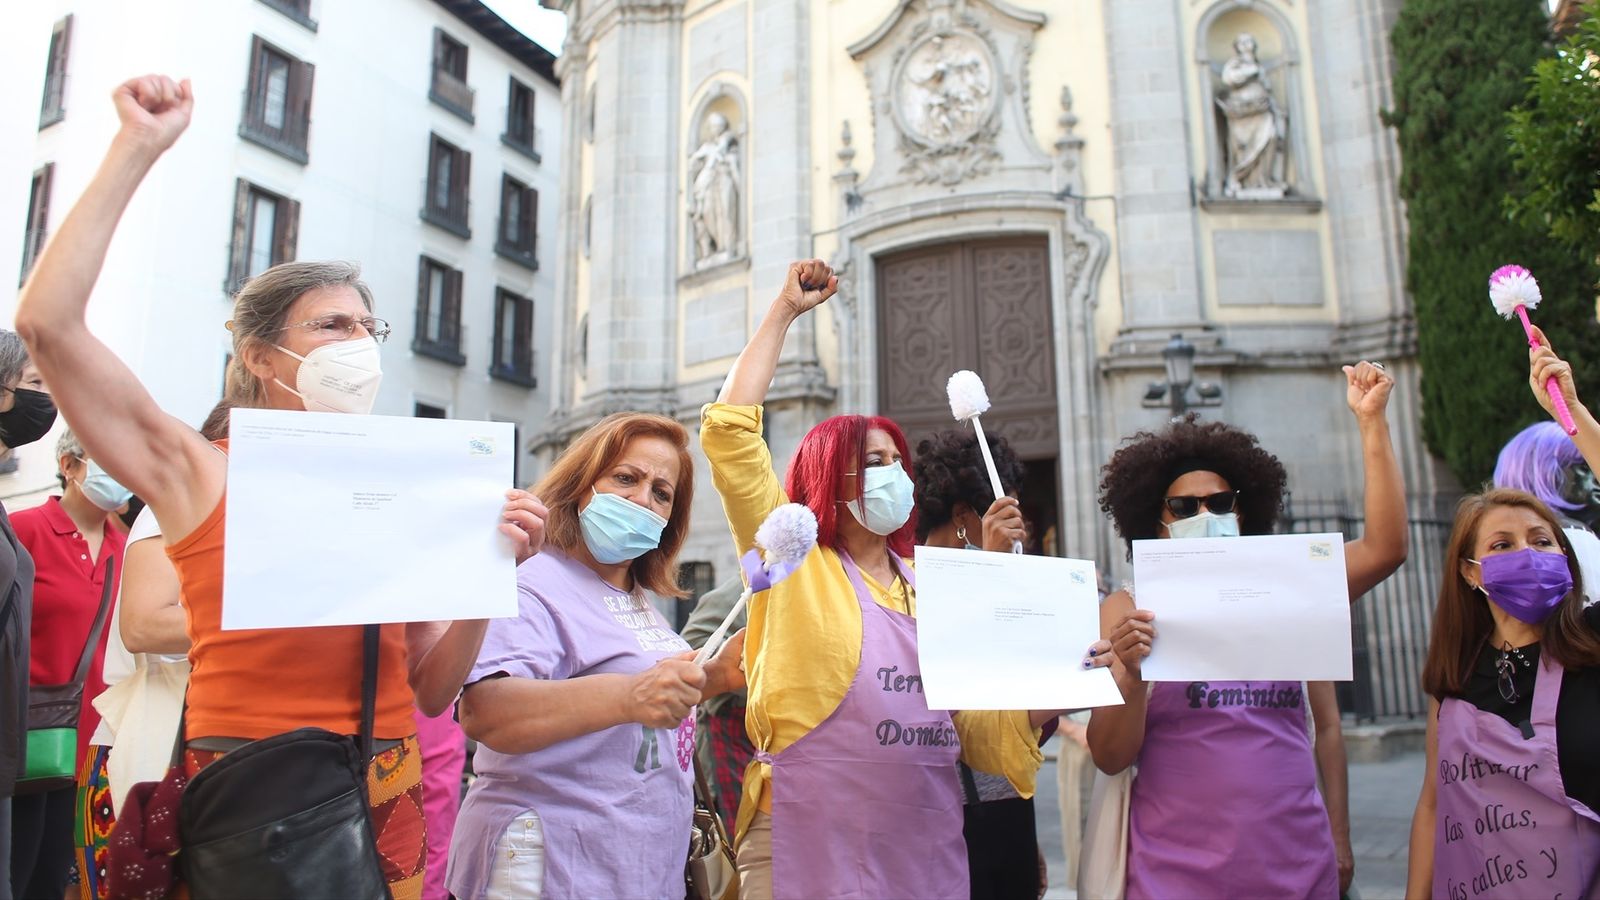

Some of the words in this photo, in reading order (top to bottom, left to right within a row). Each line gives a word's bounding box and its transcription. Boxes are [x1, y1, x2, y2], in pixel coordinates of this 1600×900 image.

[603, 595, 620, 612] SE
[1444, 816, 1464, 844] las
[1475, 804, 1537, 835] ollas,
[1472, 855, 1528, 895] calles
[1539, 847, 1557, 878] y
